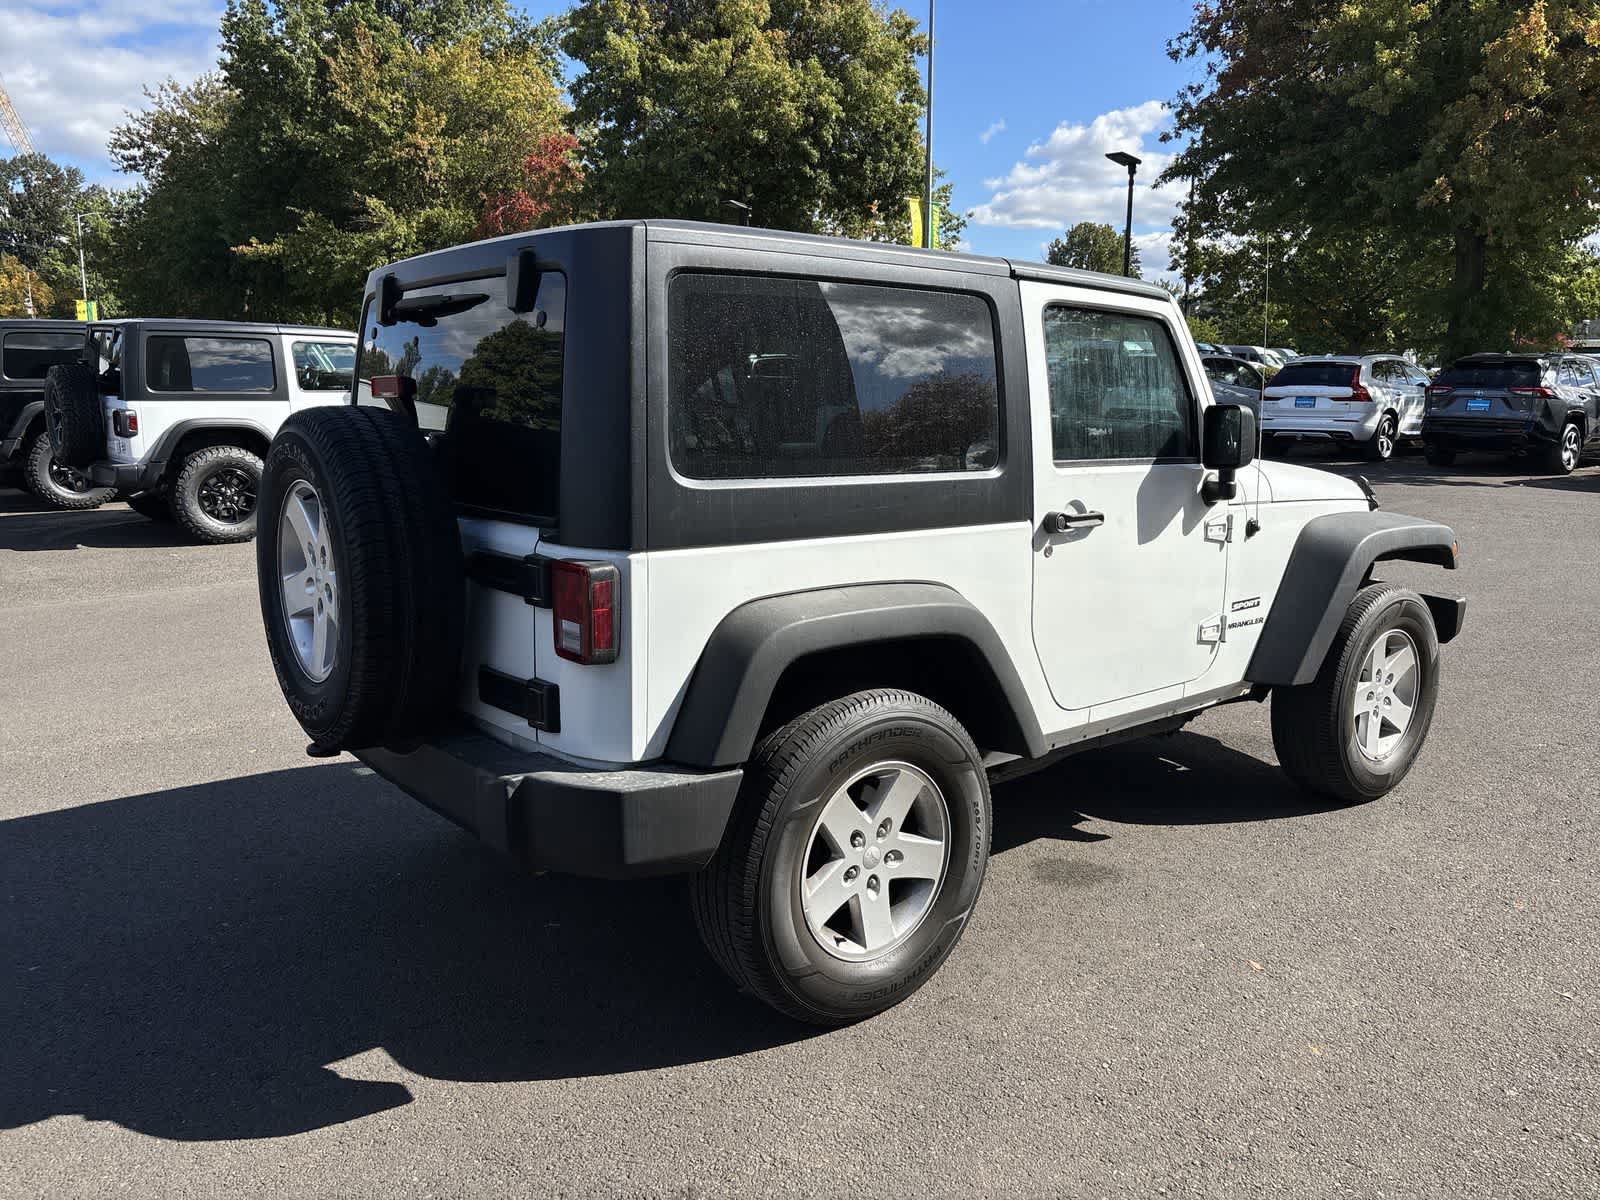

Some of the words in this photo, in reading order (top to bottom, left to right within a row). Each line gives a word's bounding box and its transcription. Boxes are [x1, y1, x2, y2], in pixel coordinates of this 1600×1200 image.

[1232, 597, 1260, 612] SPORT
[1227, 617, 1264, 630] WRANGLER
[829, 727, 921, 774] PATHFINDER
[972, 800, 982, 872] 265/70R17
